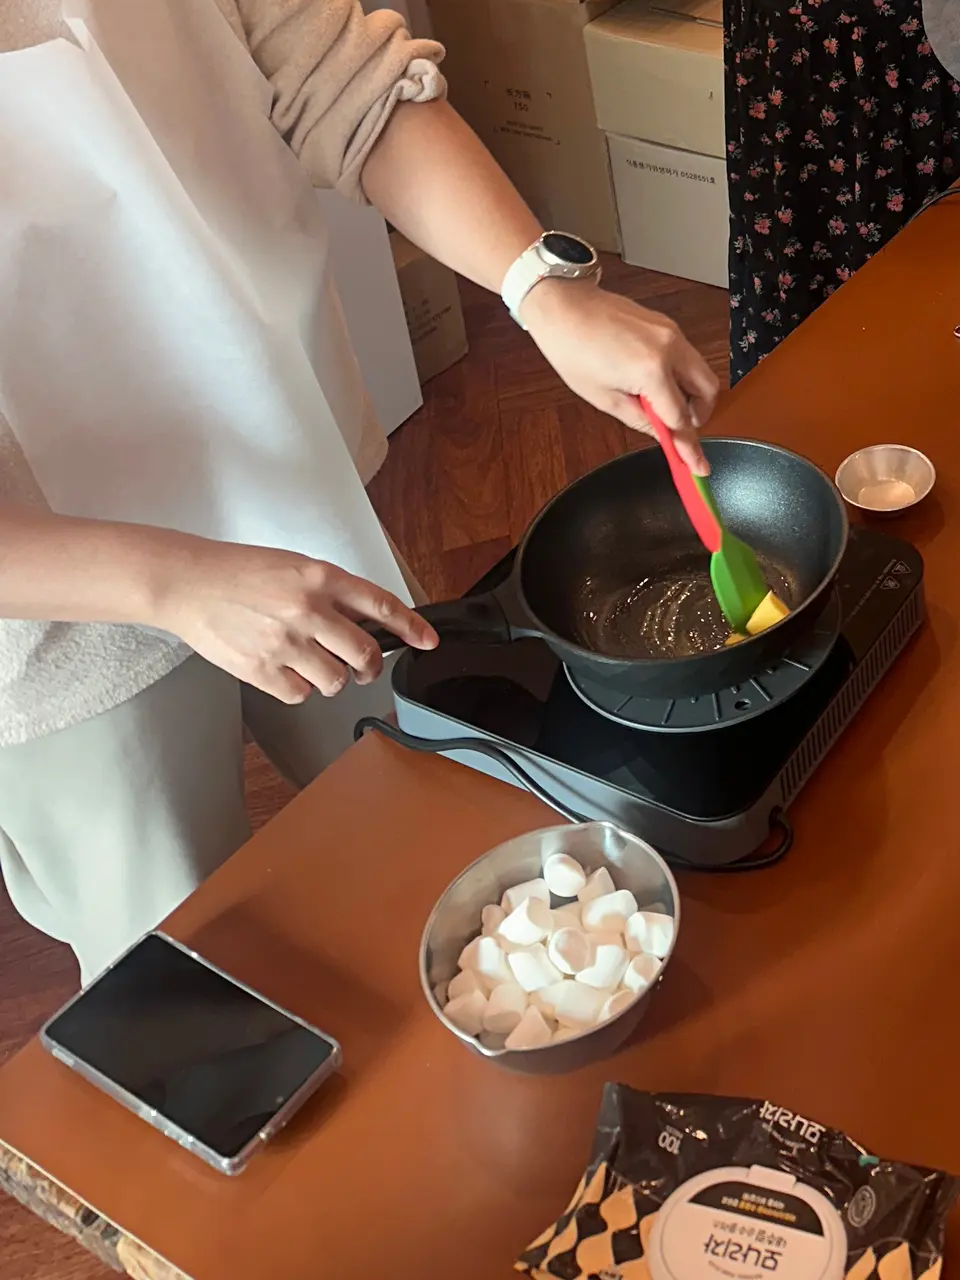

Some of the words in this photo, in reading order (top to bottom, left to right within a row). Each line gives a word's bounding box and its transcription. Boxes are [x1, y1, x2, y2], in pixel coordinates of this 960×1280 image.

[759, 1100, 828, 1144] 모나리자
[658, 1131, 681, 1156] 100
[703, 1233, 784, 1273] 모나리자
